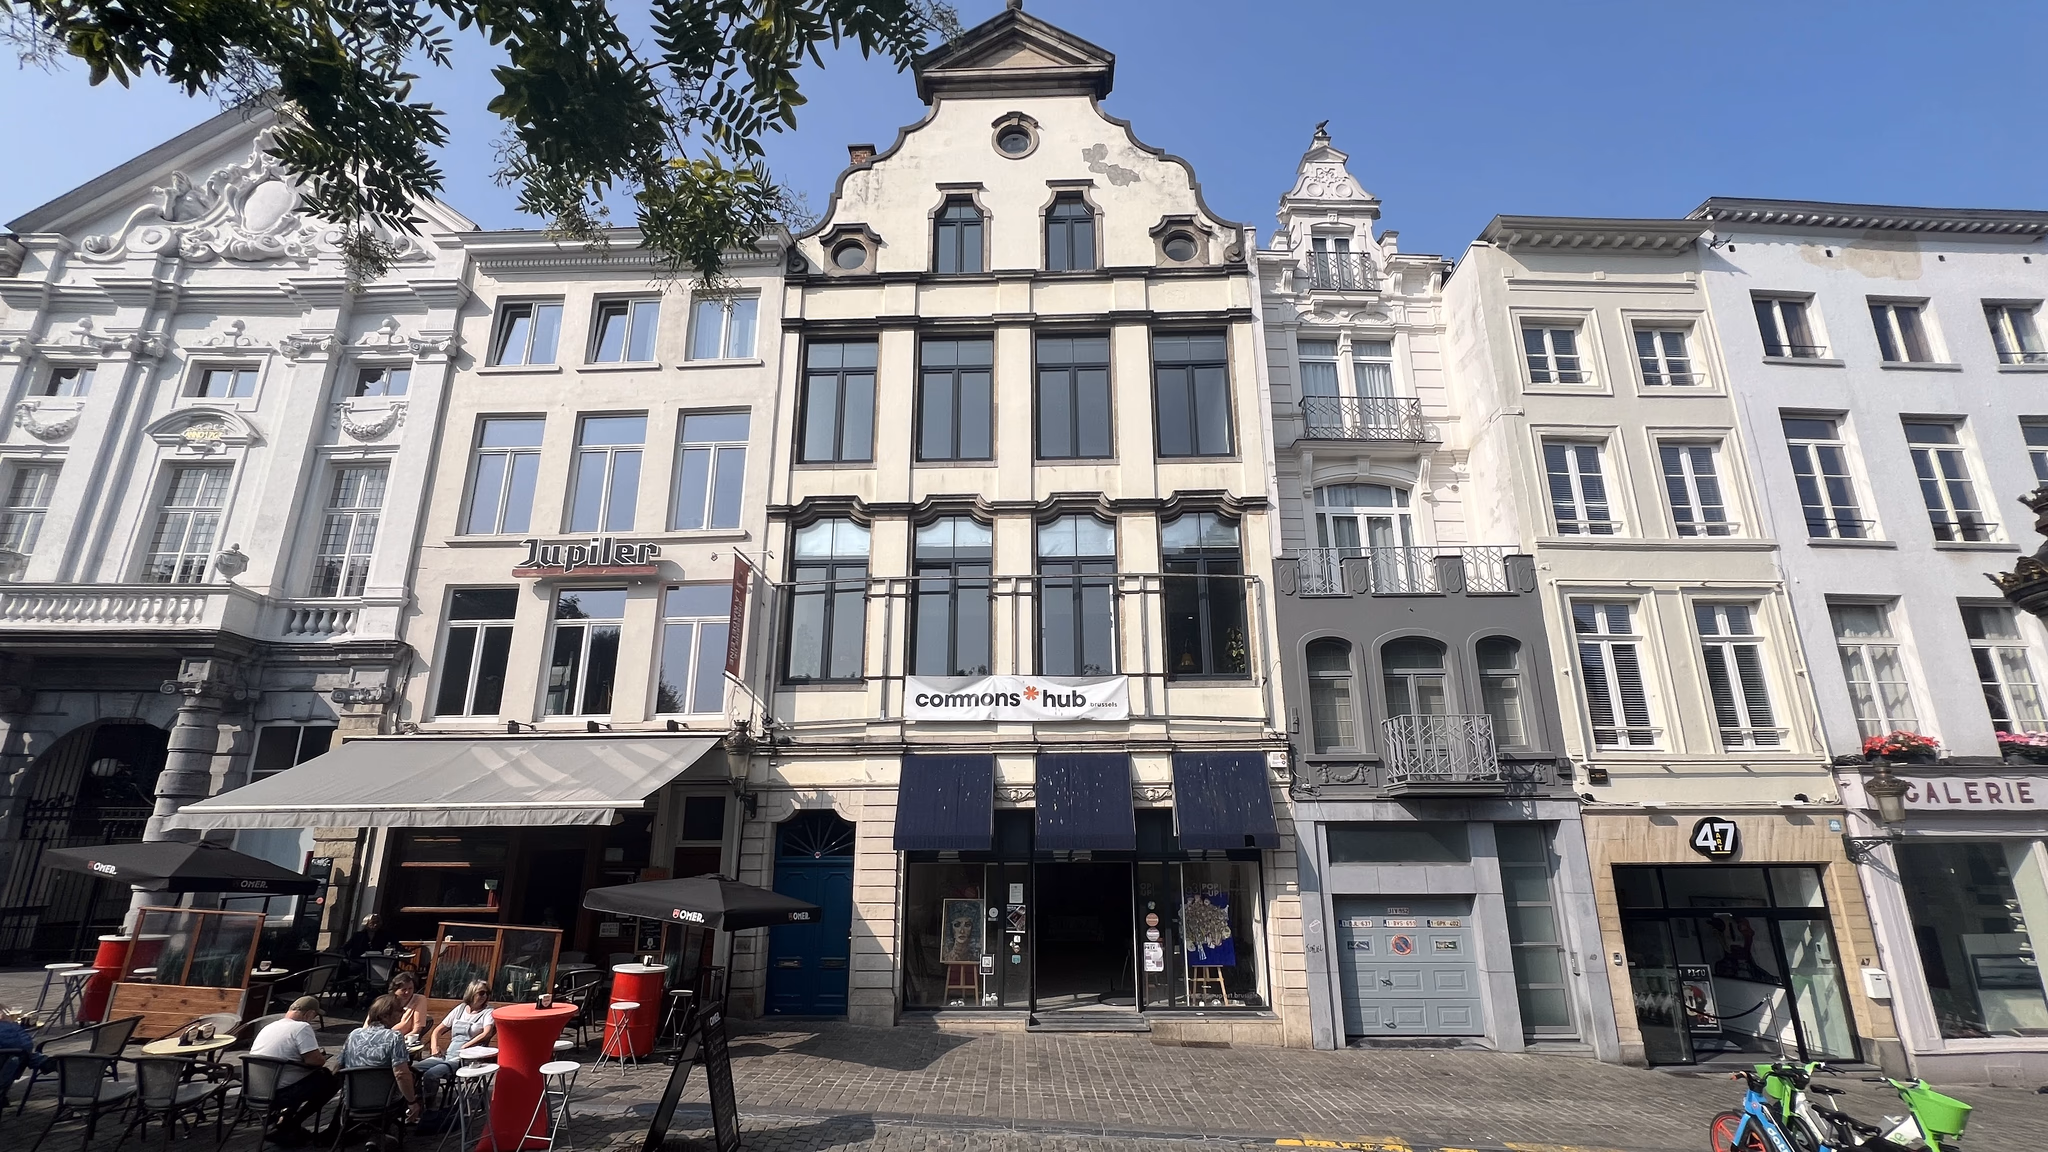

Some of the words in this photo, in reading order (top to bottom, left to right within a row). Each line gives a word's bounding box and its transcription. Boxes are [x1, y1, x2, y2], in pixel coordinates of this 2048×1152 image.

[514, 537, 661, 573] Jupiler
[728, 605, 738, 667] MADELEINE
[915, 691, 1021, 708] commons
[1042, 689, 1087, 708] hub
[1904, 782, 2035, 804] GALERIE
[1695, 822, 1735, 852] 47
[1715, 832, 1724, 851] ART
[1860, 957, 1871, 966] 47
